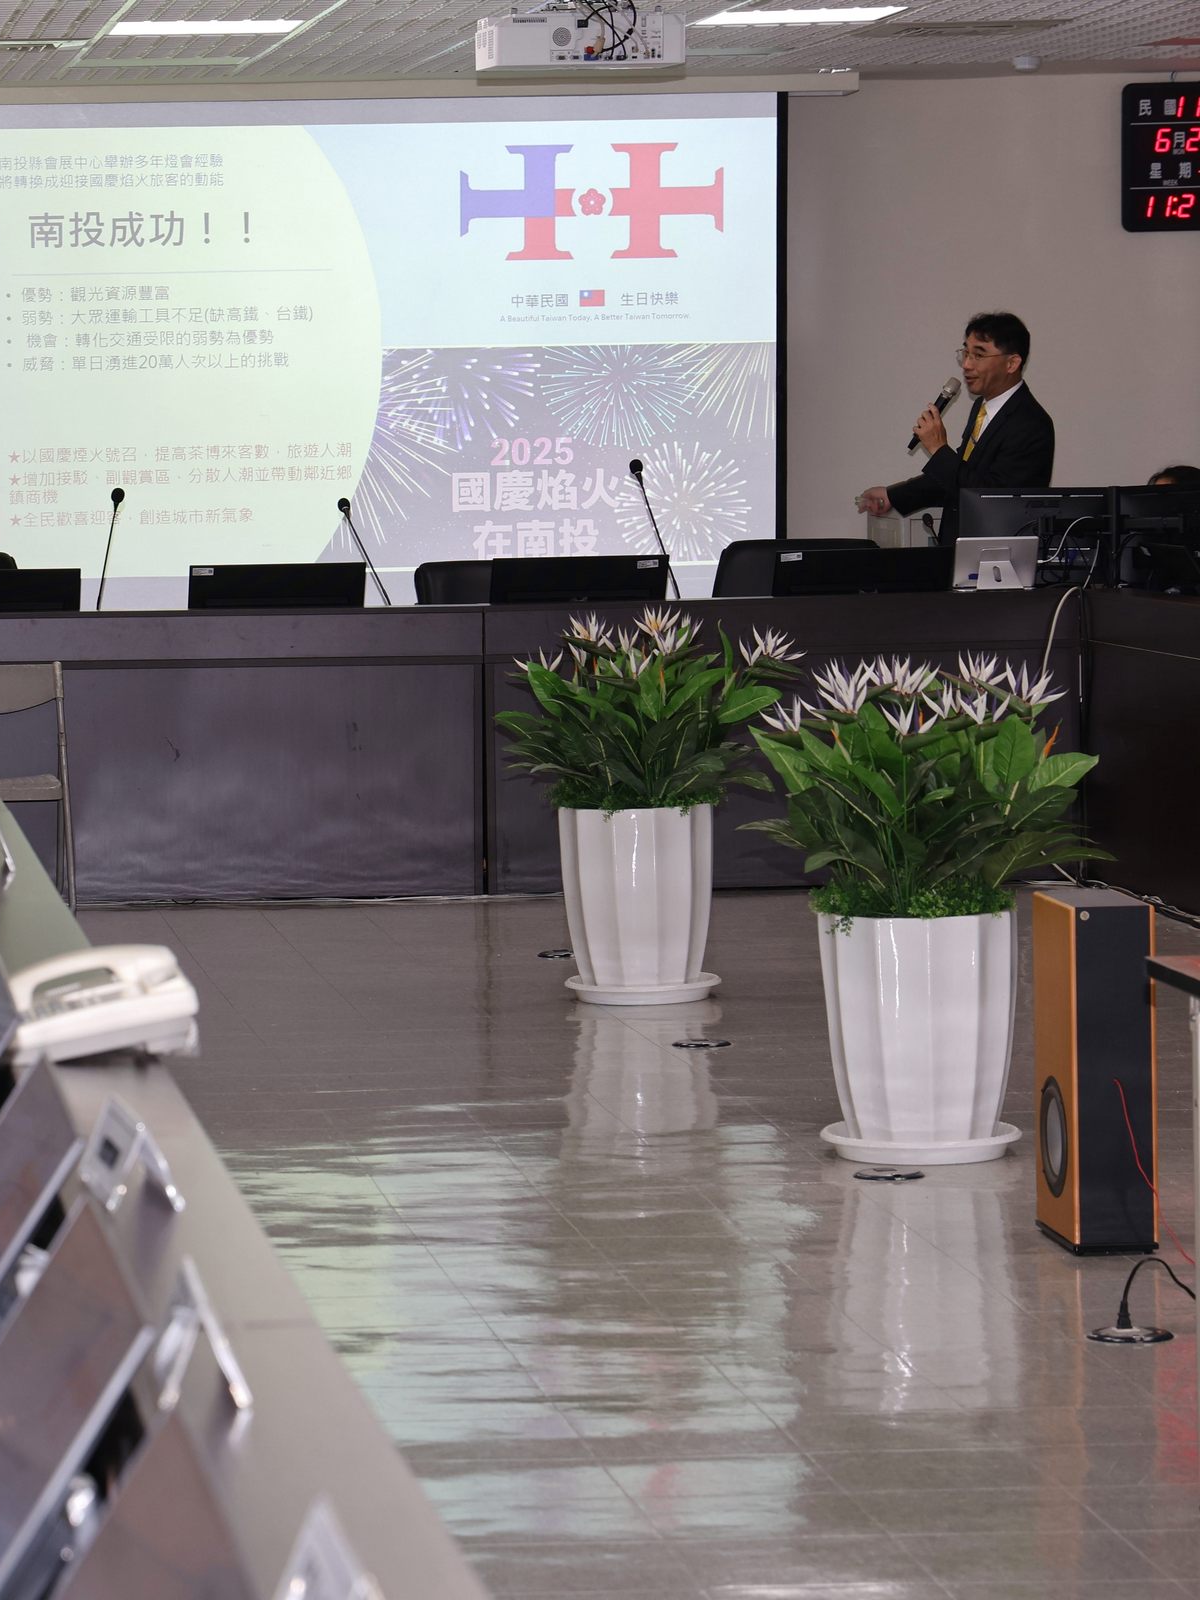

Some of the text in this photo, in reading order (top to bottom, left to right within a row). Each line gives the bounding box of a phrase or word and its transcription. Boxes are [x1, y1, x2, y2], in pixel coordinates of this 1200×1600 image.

[0, 172, 225, 190] 將轉換成迎接國慶焰火旅客的動能
[511, 291, 679, 308] 中華民國 生日快樂
[507, 315, 540, 323] Beautiful
[601, 313, 623, 321] Better
[625, 313, 650, 321] Taiwan
[490, 436, 574, 466] 2025
[452, 468, 620, 513] 國慶焰火
[472, 518, 599, 560] 在南投
